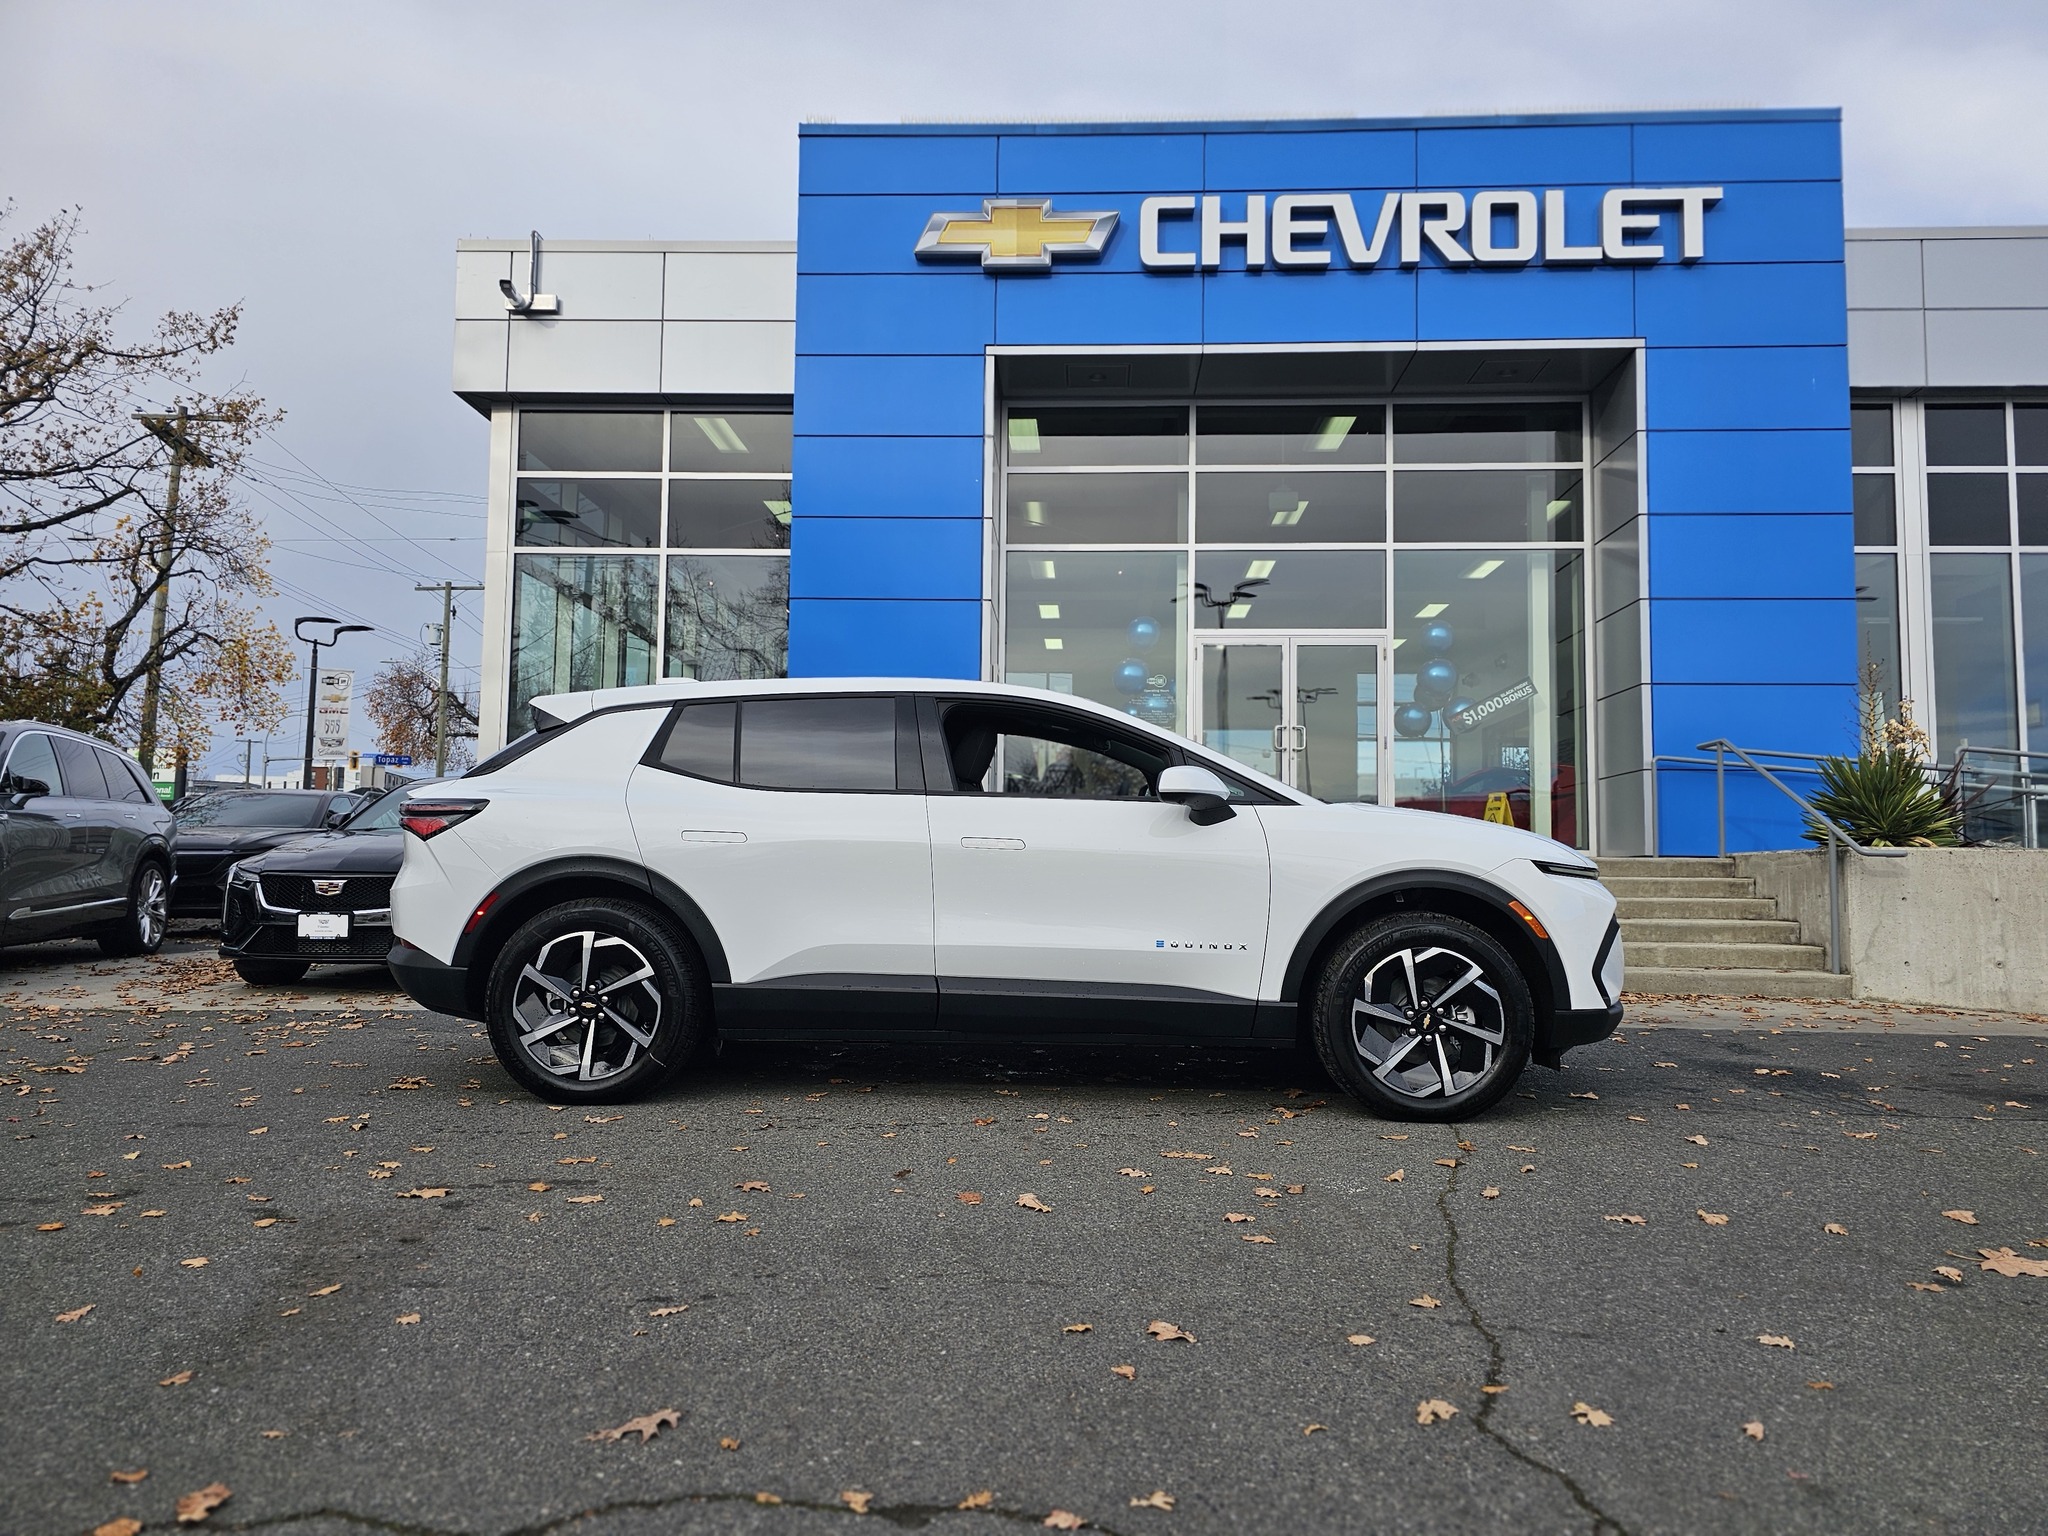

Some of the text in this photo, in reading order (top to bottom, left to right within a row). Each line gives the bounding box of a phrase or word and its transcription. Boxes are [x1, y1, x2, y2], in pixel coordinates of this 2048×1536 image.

[1139, 187, 1723, 266] CHEVROLET
[319, 706, 348, 714] GMC
[1462, 697, 1504, 725] $1,000
[378, 756, 399, 765] Topaz
[1156, 940, 1247, 951] EQUINOX
